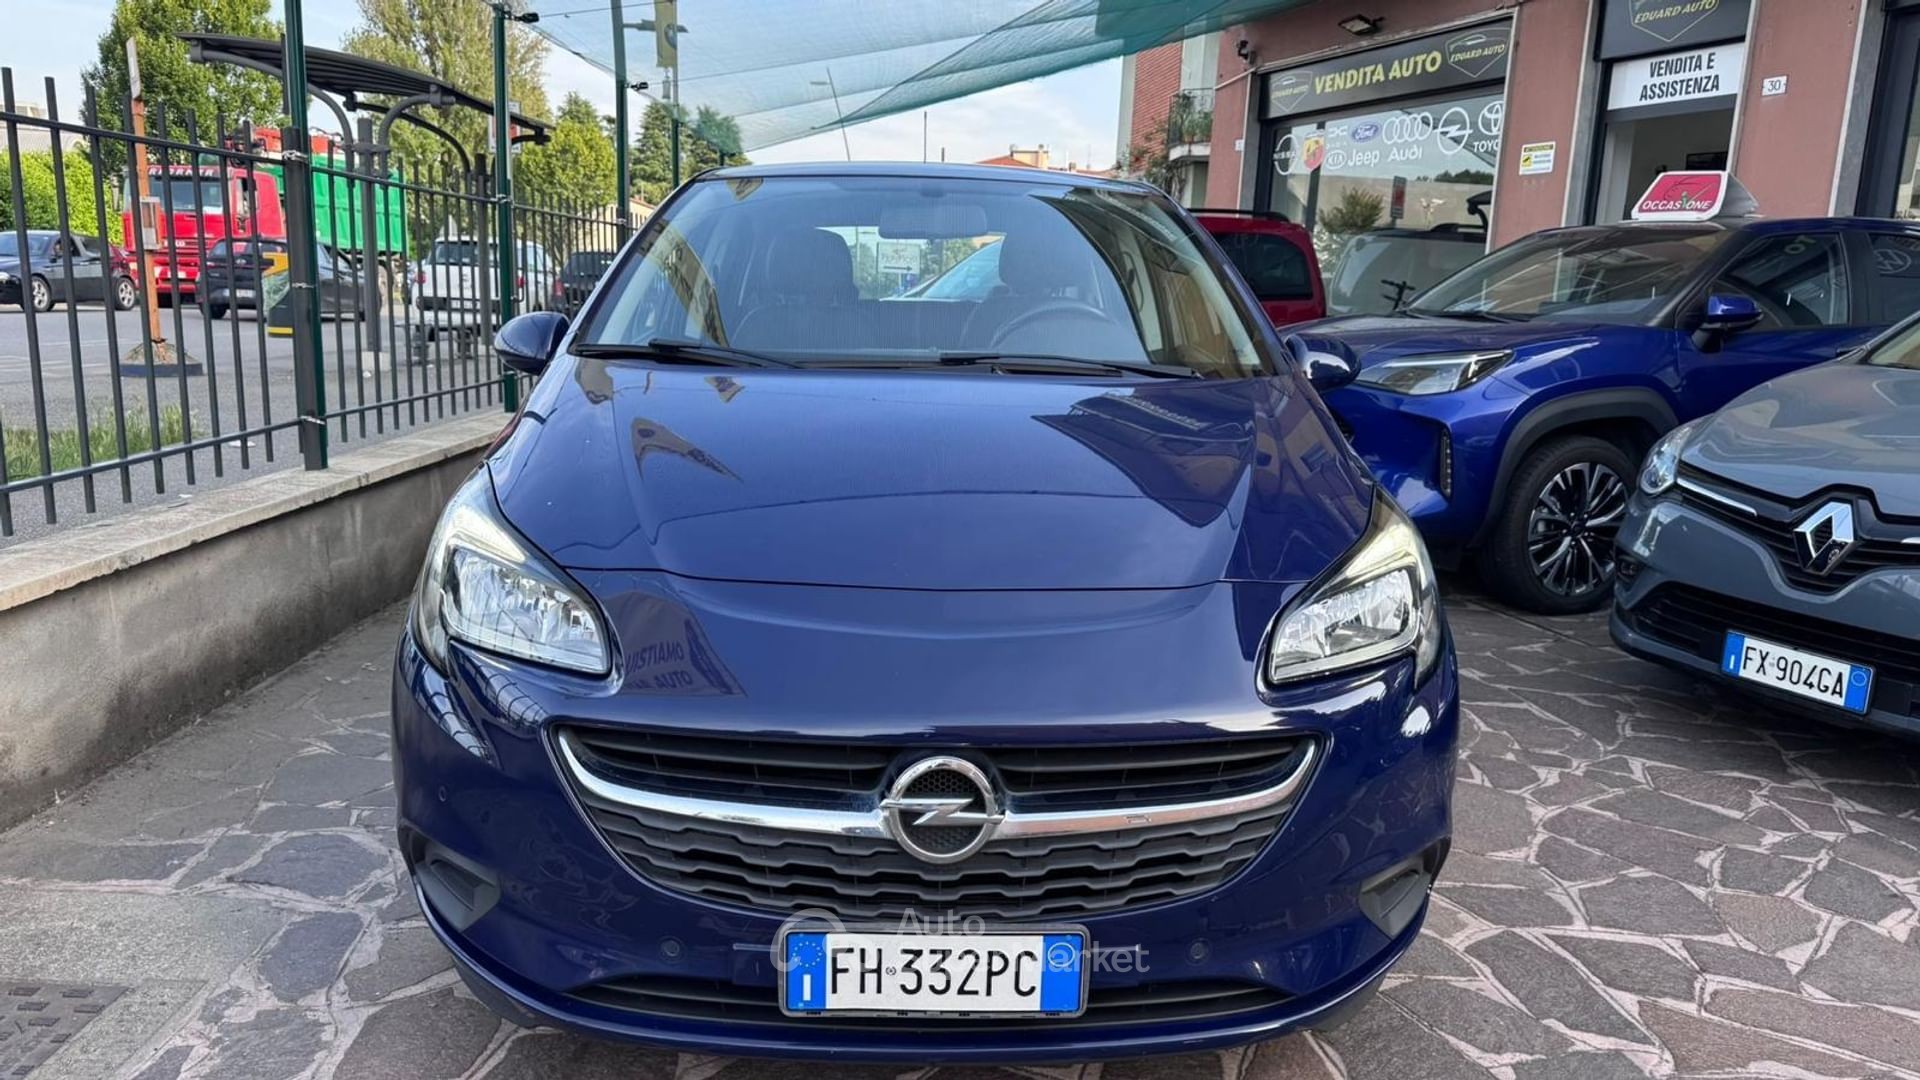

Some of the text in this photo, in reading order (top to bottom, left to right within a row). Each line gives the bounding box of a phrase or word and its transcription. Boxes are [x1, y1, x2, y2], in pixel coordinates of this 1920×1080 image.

[1634, 0, 1716, 24] EDUARD AUTO
[1483, 44, 1505, 56] AUTO
[1315, 50, 1442, 95] VENDITA AUTO
[1650, 52, 1716, 78] VENDITA E
[1639, 74, 1720, 101] ASSISTENZA
[1767, 79, 1781, 93] 30
[1348, 149, 1379, 167] Jeep
